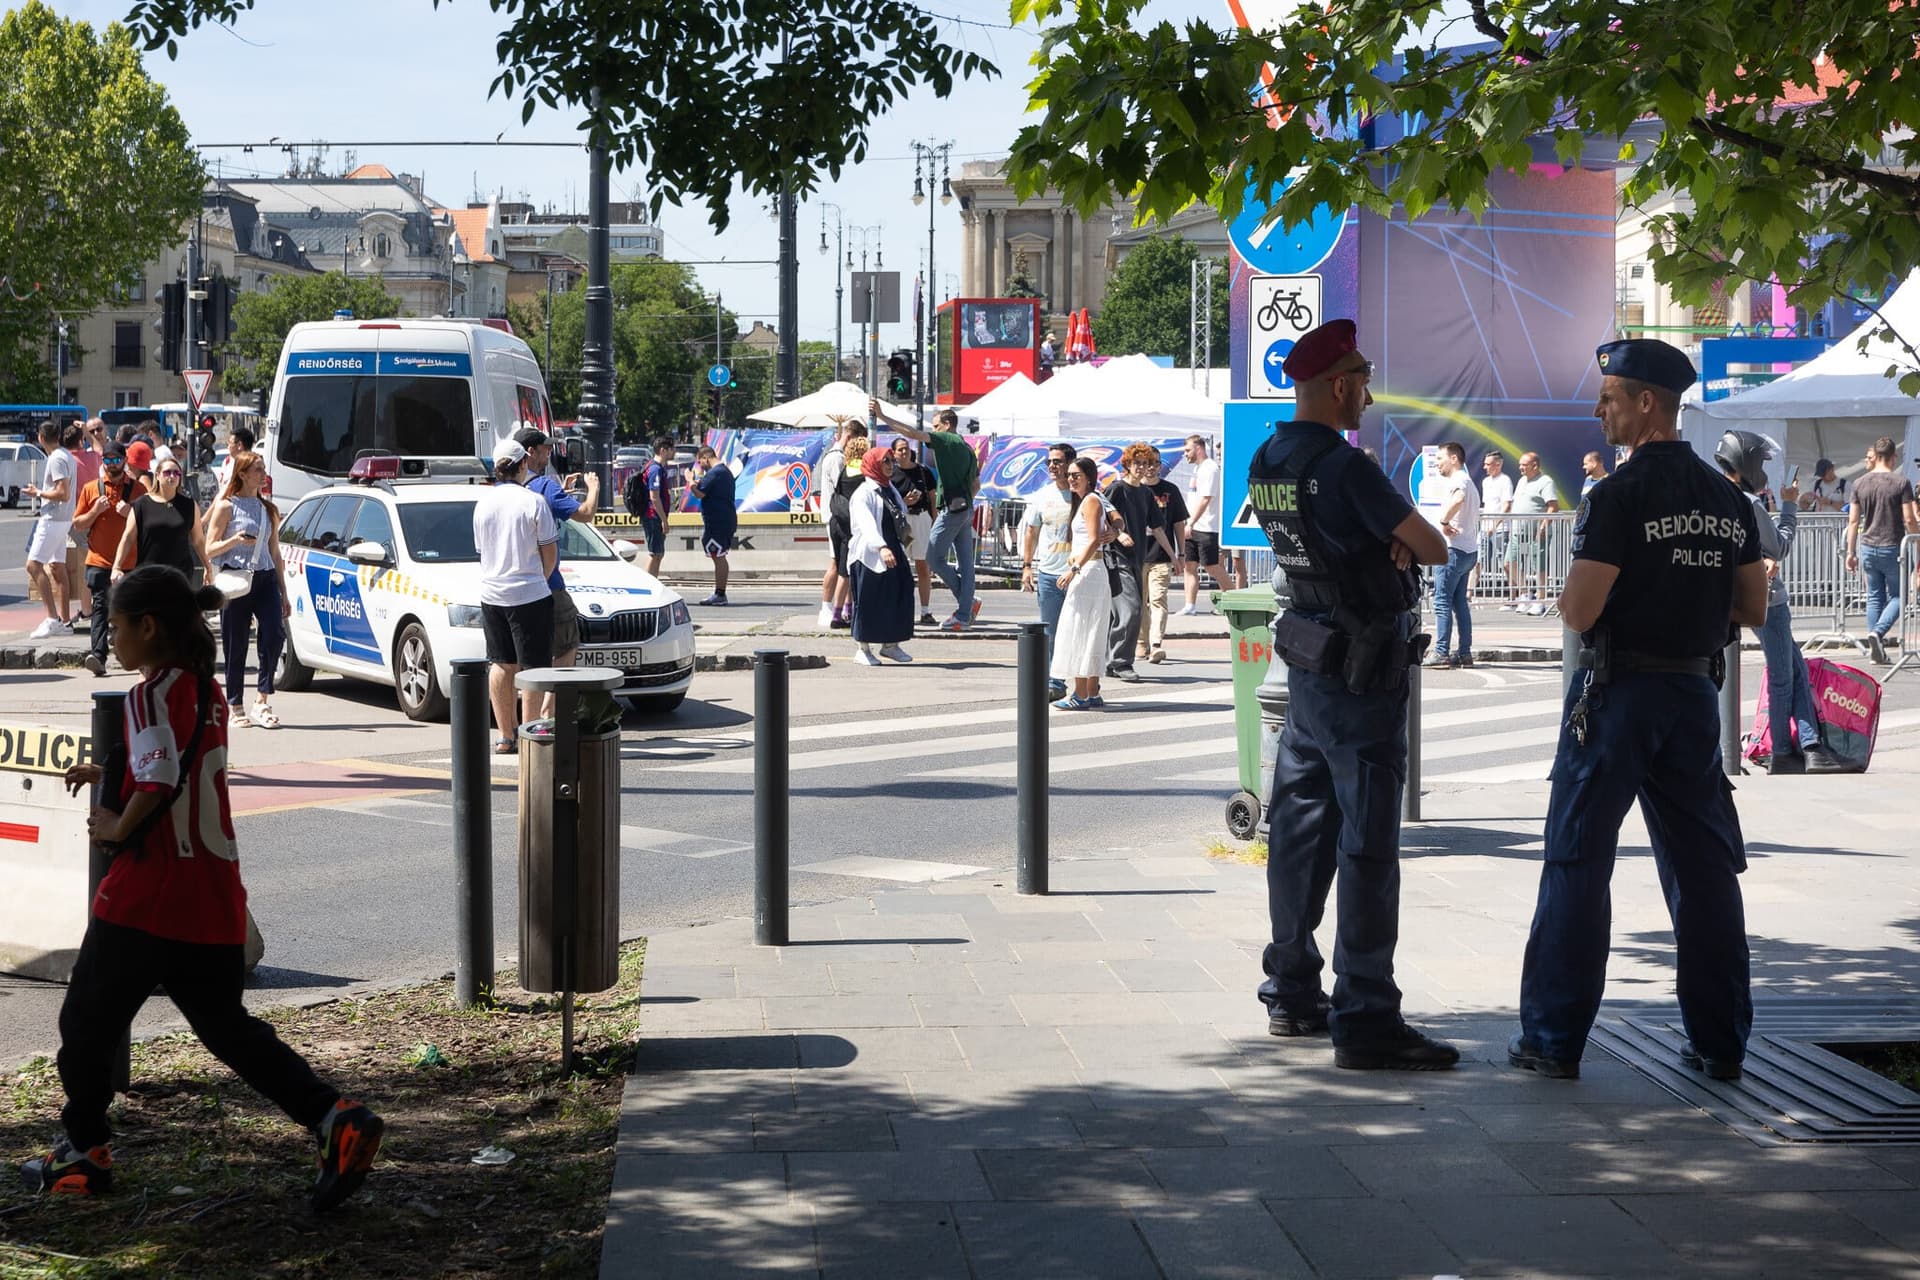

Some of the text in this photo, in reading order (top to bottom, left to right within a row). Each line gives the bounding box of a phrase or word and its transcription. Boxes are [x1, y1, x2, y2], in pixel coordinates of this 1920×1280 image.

[298, 357, 362, 369] RENDŐRSÉG
[1249, 484, 1297, 511] POLICE
[594, 514, 641, 525] POLIC
[790, 513, 820, 524] POL
[1644, 510, 1746, 548] RENDŐRSÉG
[680, 536, 756, 550] TK
[1672, 548, 1722, 567] POLICE
[315, 594, 361, 619] RENDŐRSÉG
[575, 651, 637, 666] PMB-955
[0, 728, 92, 770] OLICE
